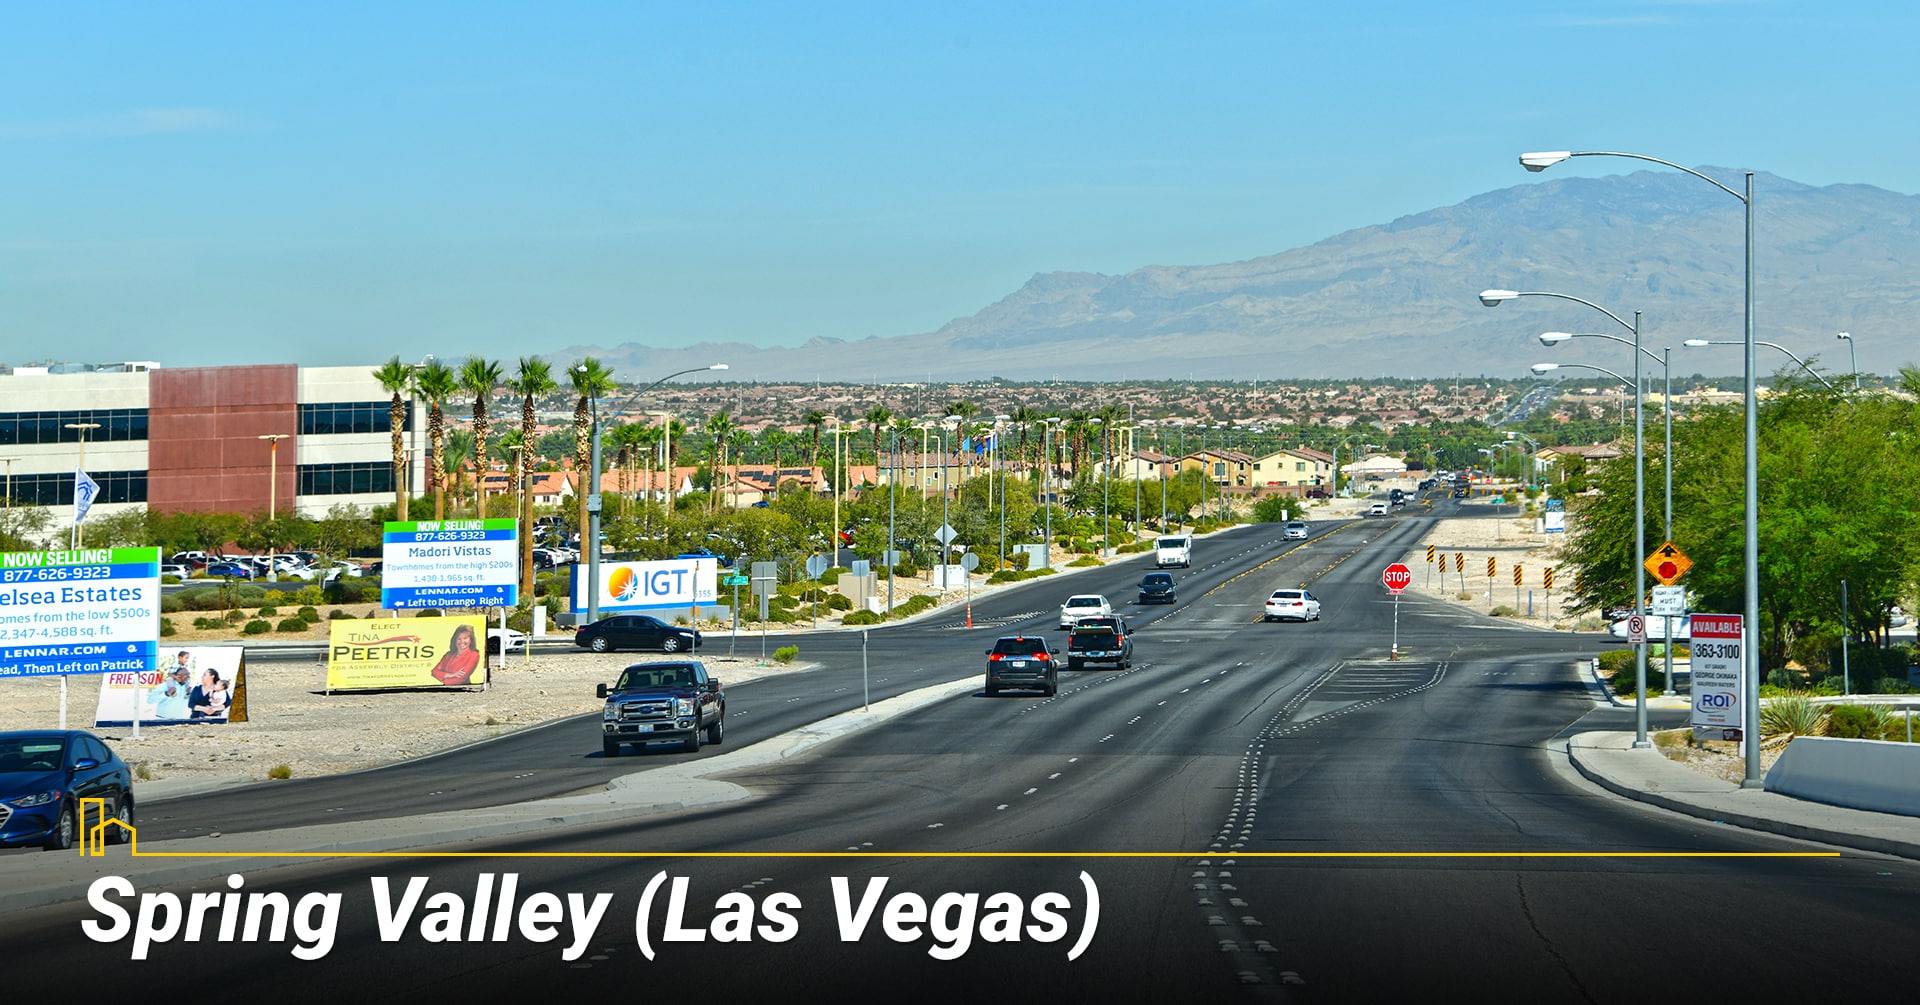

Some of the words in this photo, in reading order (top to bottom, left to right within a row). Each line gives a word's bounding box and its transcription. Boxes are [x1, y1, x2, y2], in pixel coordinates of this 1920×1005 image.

[417, 521, 440, 532] NOW
[443, 520, 485, 531] SELLING!
[415, 531, 486, 541] 877-626-9323
[3, 552, 43, 568] NOW
[46, 549, 113, 566] SELLING!
[408, 547, 451, 558] Madori
[453, 546, 492, 557] Vistas
[386, 563, 434, 571] Townhomes
[435, 562, 455, 570] from
[455, 561, 468, 569] the
[469, 561, 487, 571] high
[488, 560, 514, 569] $200s
[3, 566, 111, 582] 877-626-9323
[1385, 571, 1410, 582] STOP
[644, 568, 688, 597] IGT
[61, 586, 142, 604] Estates
[415, 587, 484, 596] LENNAR.COM
[407, 598, 426, 607] Left
[427, 598, 437, 606] to
[438, 597, 476, 608] Durango
[479, 595, 504, 607] Right
[33, 611, 63, 623] from
[66, 611, 85, 621] the
[88, 609, 110, 619] low
[112, 607, 151, 620] $500s
[0, 627, 78, 641] 2,347-4,588
[80, 627, 97, 638] sq.
[100, 625, 114, 636] ft.
[1692, 621, 1741, 634] AVAILABLE
[348, 633, 381, 642] TINA
[4, 645, 107, 659] LENNAR.COM
[333, 646, 435, 661] PEETRIS
[1695, 643, 1740, 659] 363-3100
[23, 662, 55, 674] Then
[57, 660, 82, 672] Left
[83, 661, 99, 671] on
[101, 659, 144, 670] Patrick
[109, 671, 164, 685] FRIESON
[1702, 694, 1729, 707] ROI
